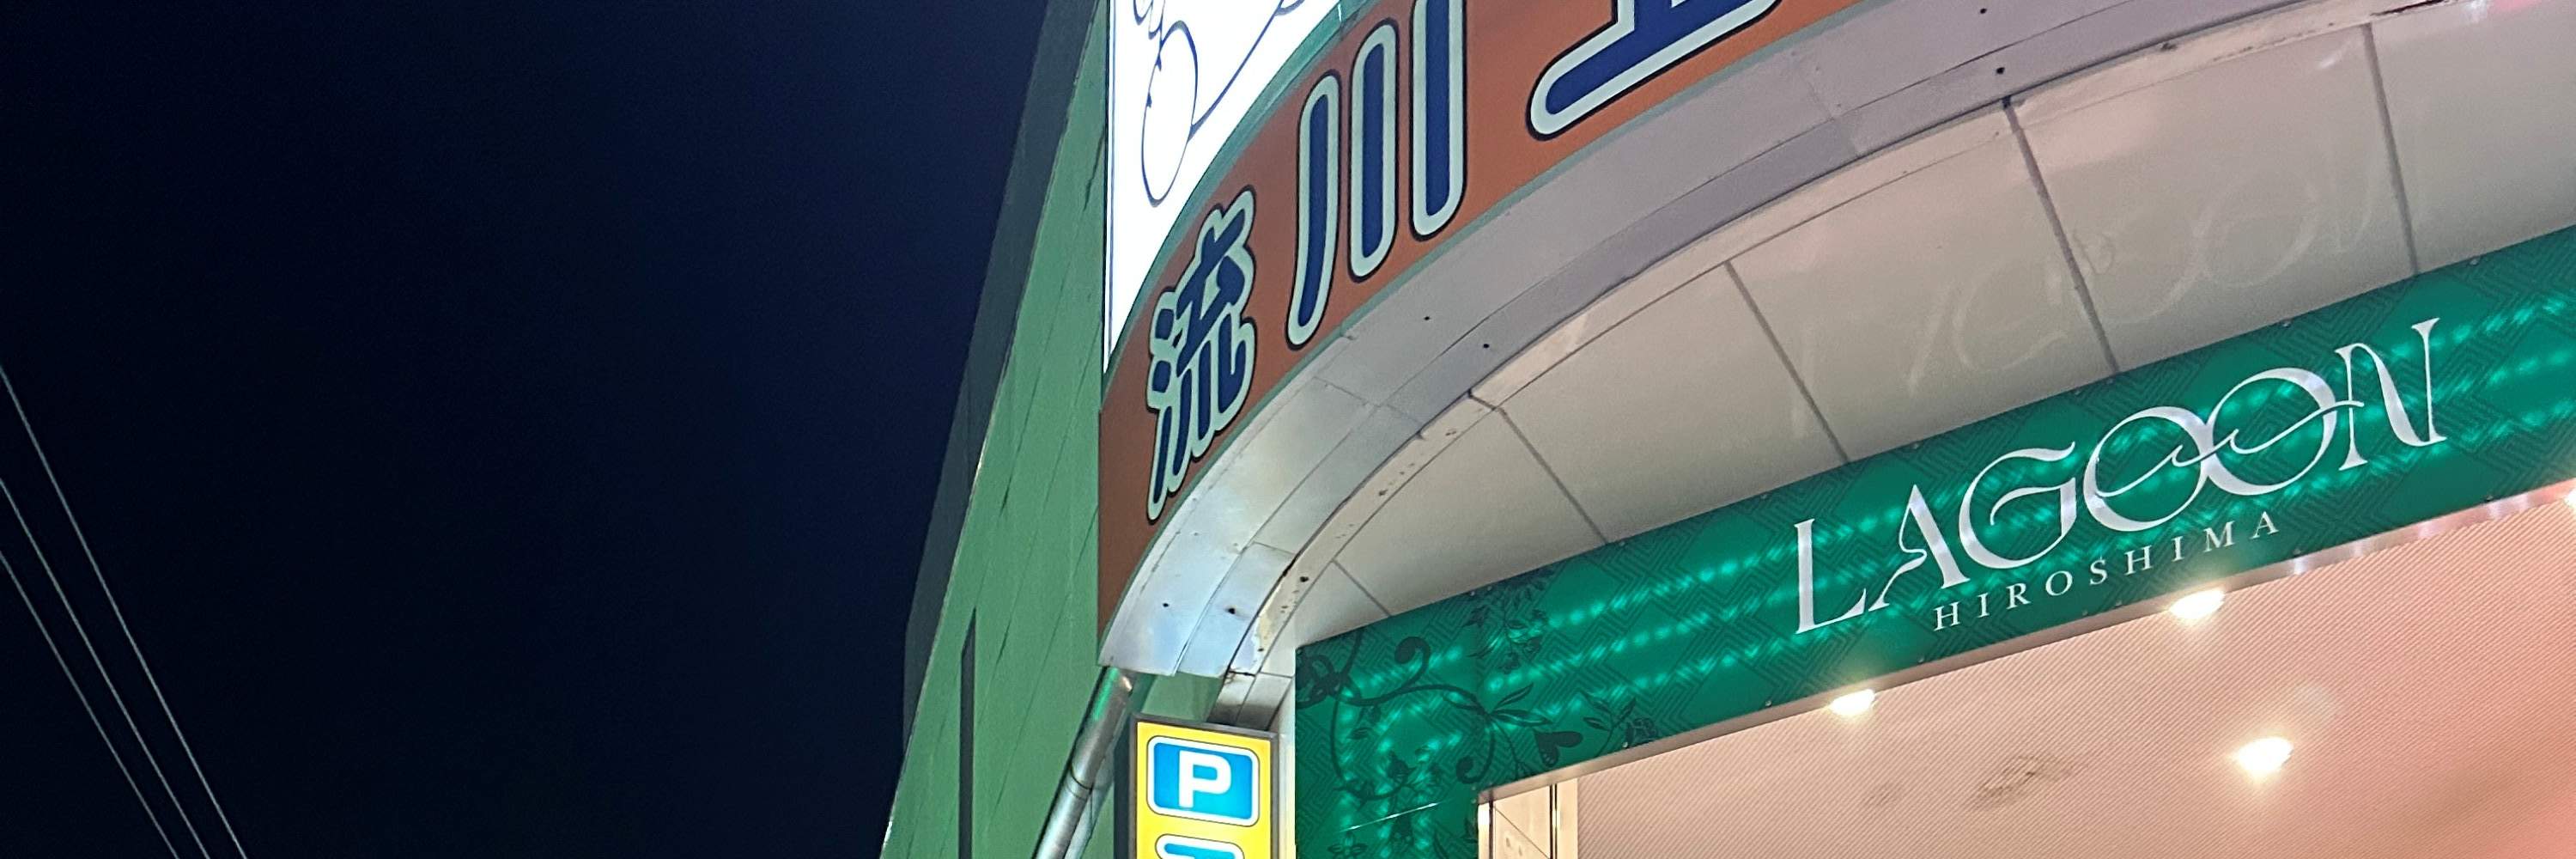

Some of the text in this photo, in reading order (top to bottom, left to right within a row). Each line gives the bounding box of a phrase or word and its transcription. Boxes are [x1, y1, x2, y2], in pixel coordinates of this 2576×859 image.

[1794, 317, 2447, 635] LAGOON
[1933, 510, 2279, 631] HIROSHIMA
[1178, 751, 1231, 808] P
